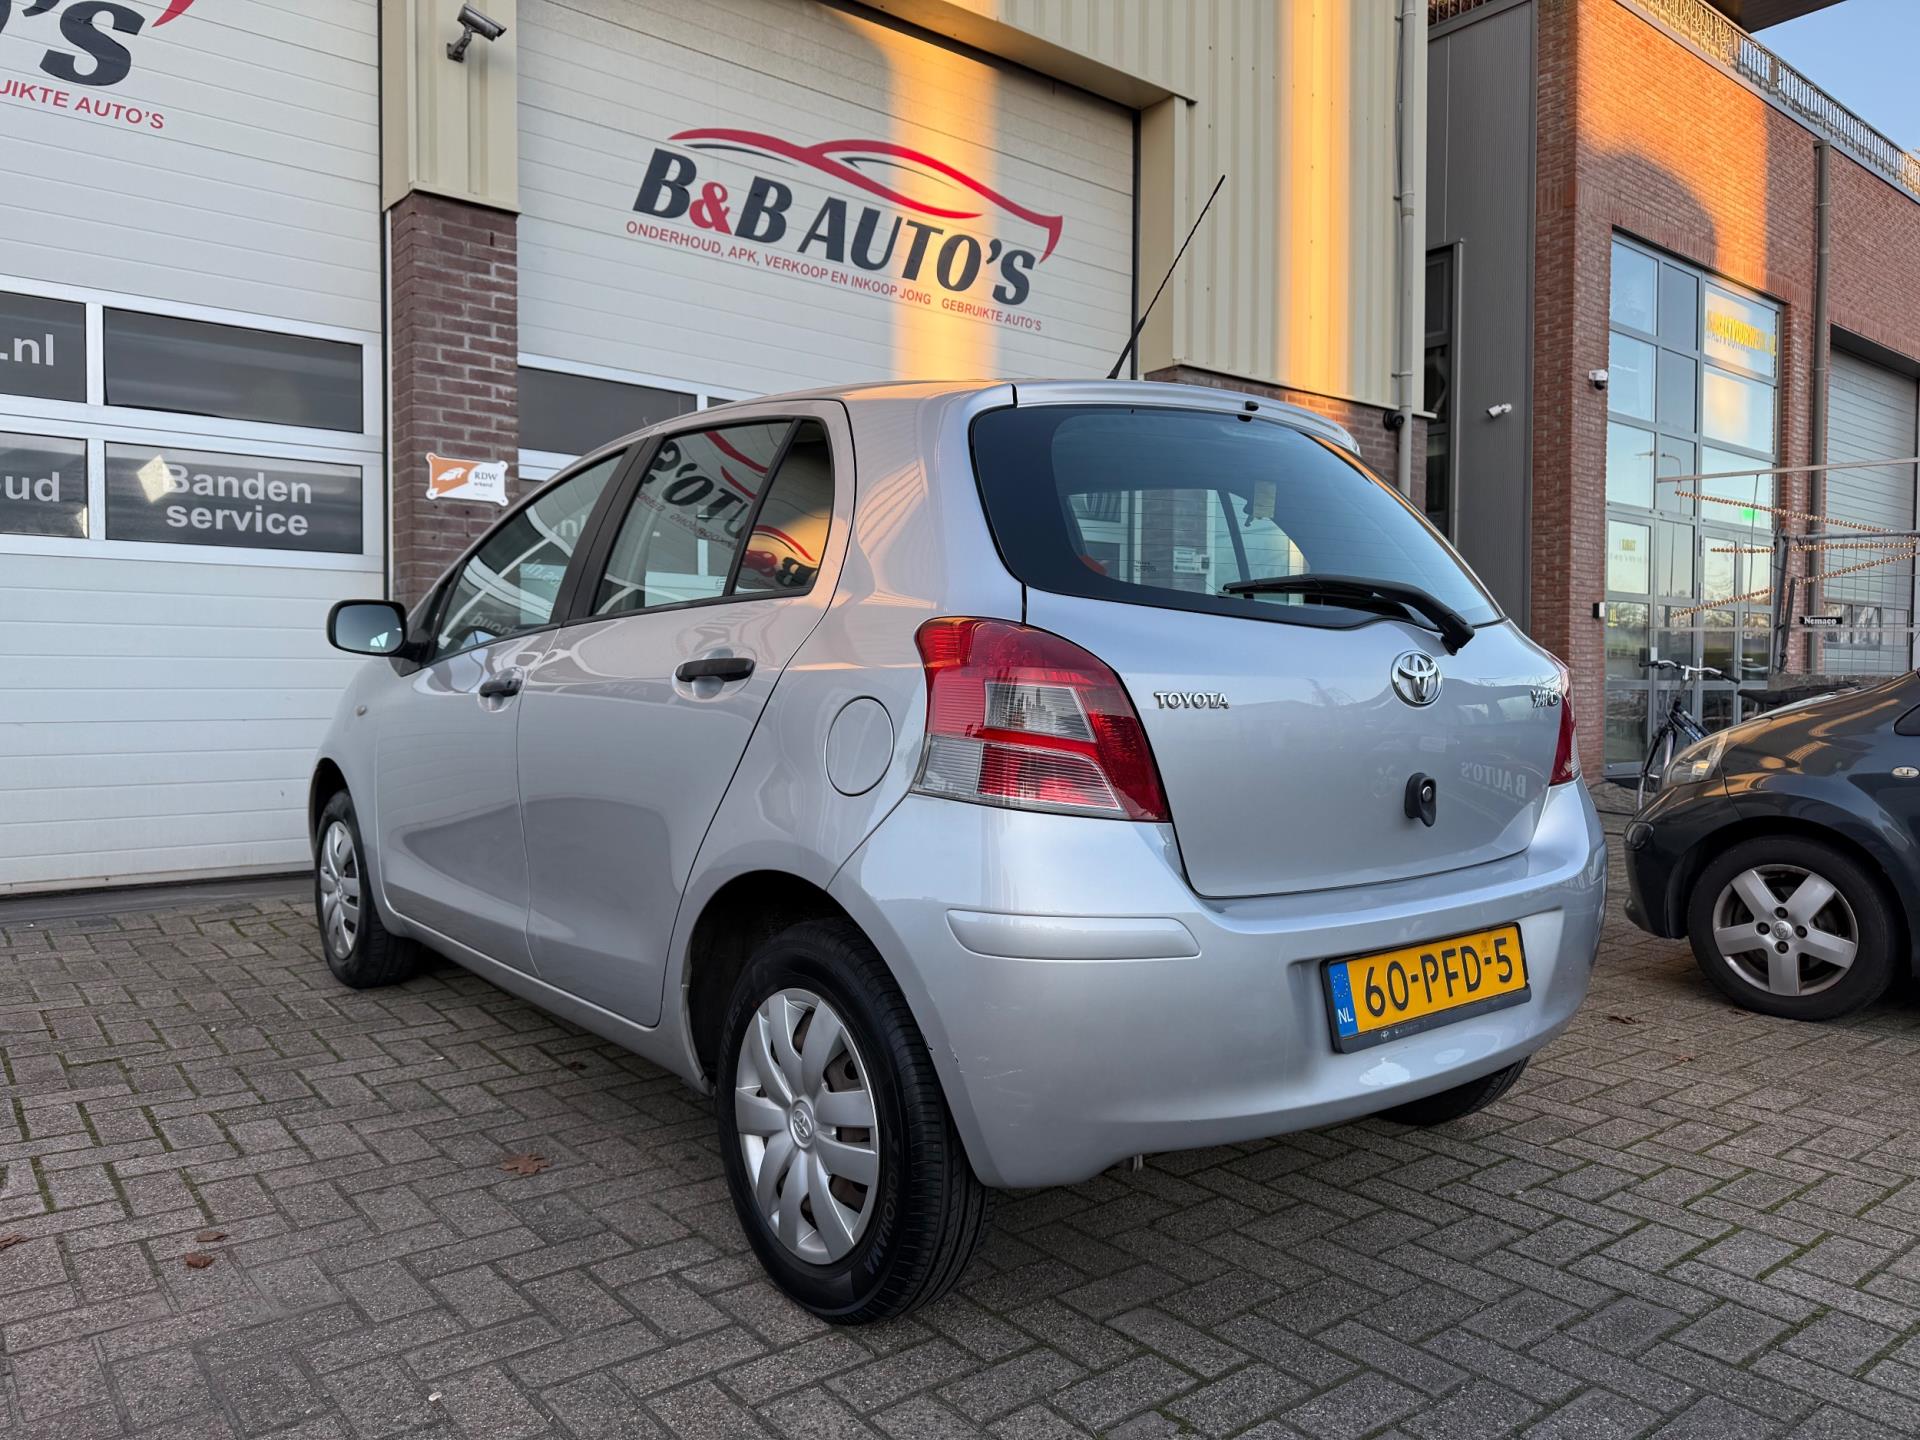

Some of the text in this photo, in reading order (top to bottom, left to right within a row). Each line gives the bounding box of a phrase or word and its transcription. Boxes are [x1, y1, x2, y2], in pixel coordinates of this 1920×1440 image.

[75, 96, 164, 129] AUTO'S
[633, 148, 1036, 305] B&B AUTO'S
[626, 221, 1042, 331] ONDERHOUD, APK, VERKOOP EN INKOOP JONG GEBRUIKTE AUTO'S
[165, 463, 312, 504] Banden
[474, 471, 498, 480] RDW
[166, 504, 309, 537] service
[1153, 692, 1229, 709] TOYOTA
[1364, 937, 1514, 1017] 60-PFD-5
[1337, 1007, 1354, 1025] NL
